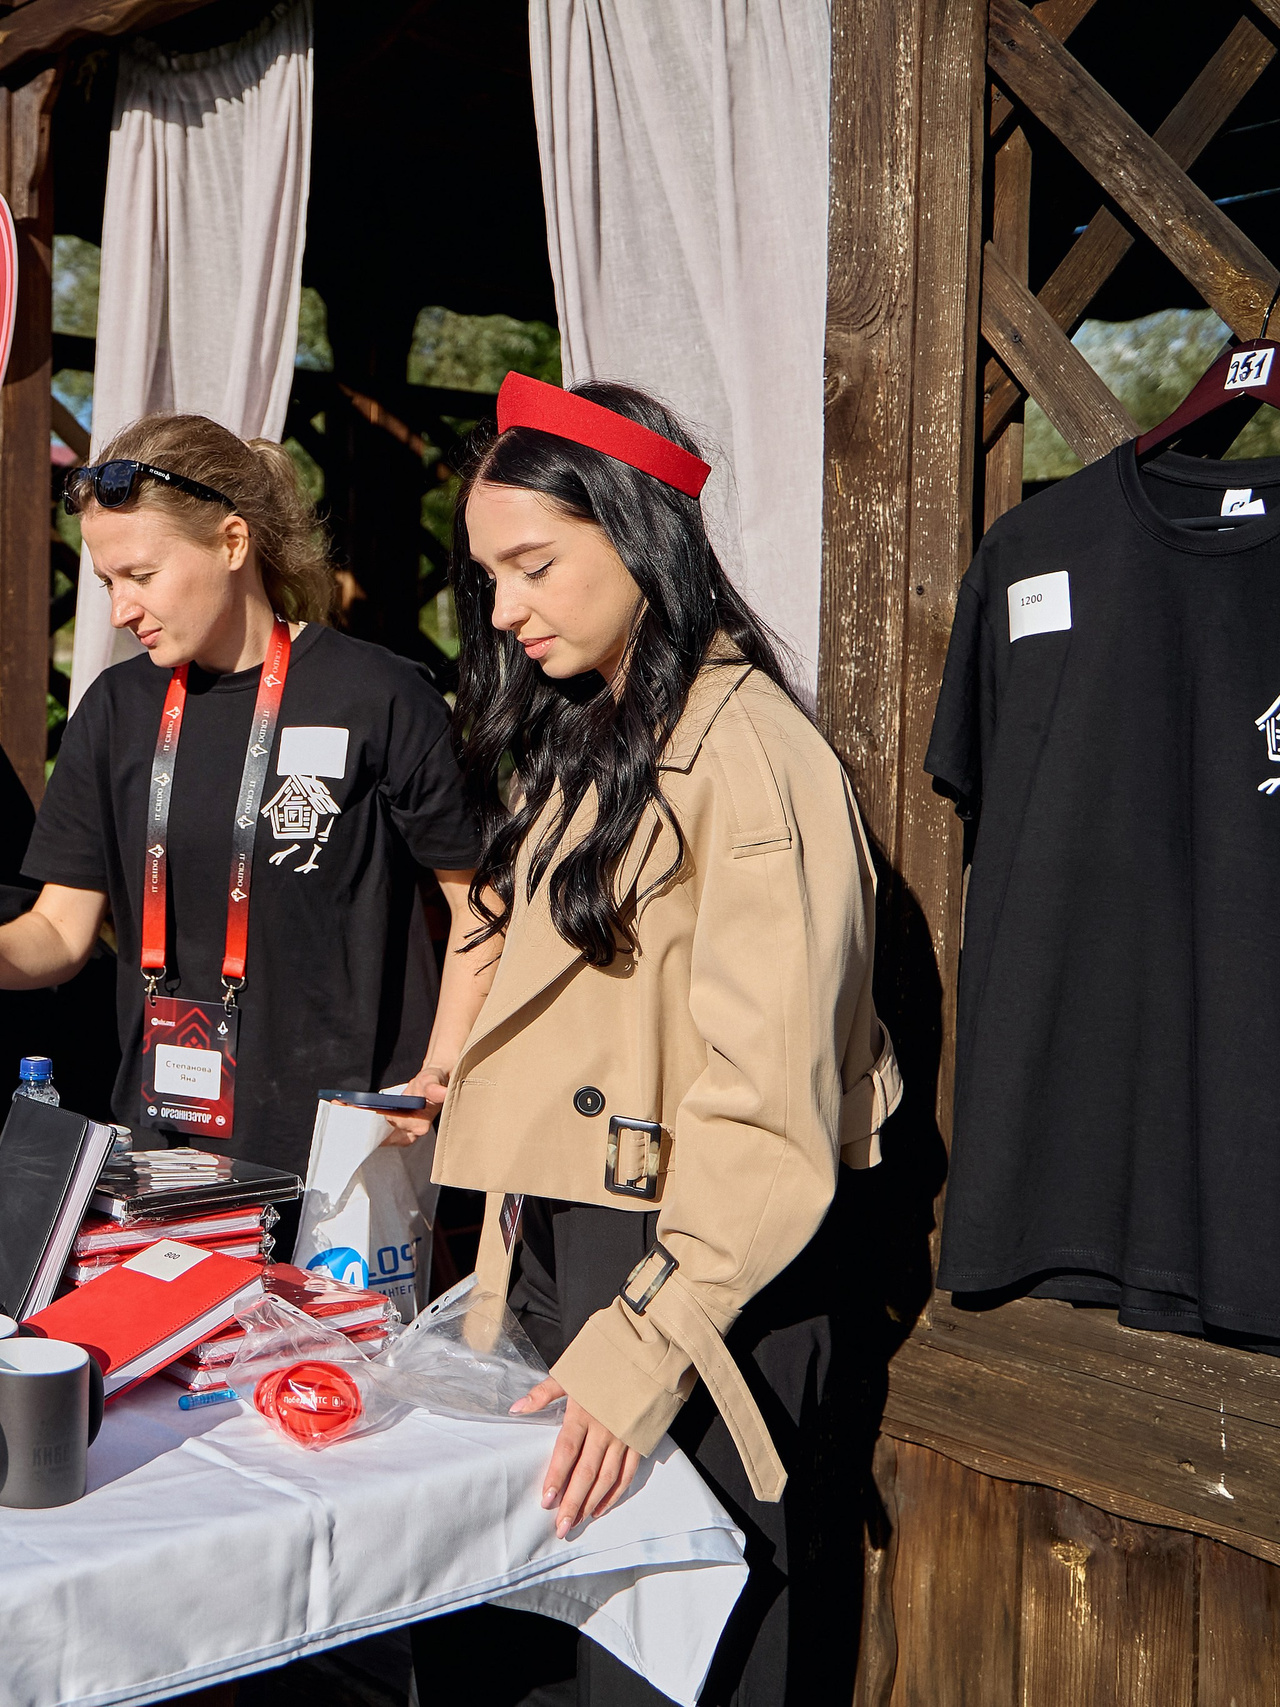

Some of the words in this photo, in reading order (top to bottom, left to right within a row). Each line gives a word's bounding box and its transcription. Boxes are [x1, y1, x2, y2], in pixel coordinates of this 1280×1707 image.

[1021, 593, 1043, 606] 1200
[165, 1060, 212, 1073] Степанова
[180, 1074, 196, 1083] Яна
[164, 1251, 181, 1260] 800
